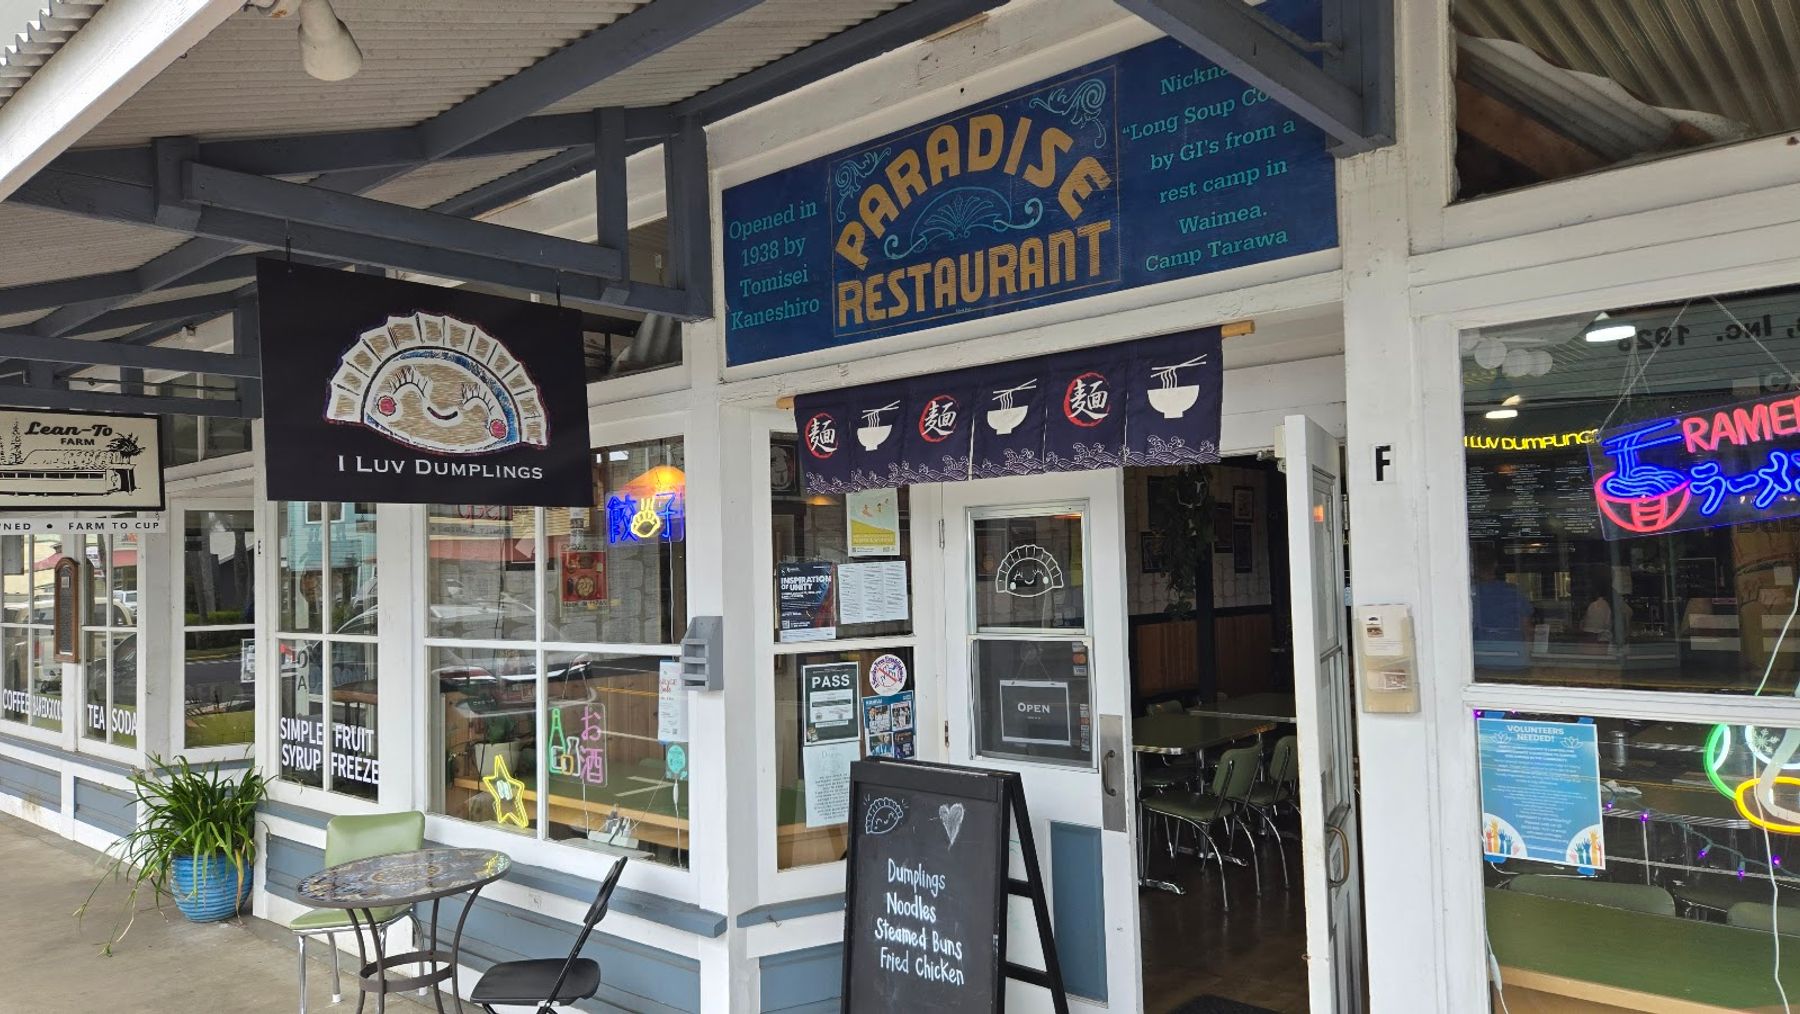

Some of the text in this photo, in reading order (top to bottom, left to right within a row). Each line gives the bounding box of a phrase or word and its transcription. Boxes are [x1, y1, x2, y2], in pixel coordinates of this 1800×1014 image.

[1184, 99, 1235, 124] Soup
[1241, 87, 1274, 106] Co
[1150, 120, 1296, 170] by GI's from a
[835, 114, 1112, 271] PARADISE
[1159, 160, 1288, 203] rest camp in
[729, 200, 818, 240] Opened in
[1178, 205, 1267, 234] Waimea.
[741, 237, 806, 266] 1938 by
[1145, 230, 1288, 271] Camp Tarawa
[739, 264, 808, 297] Tomisei
[838, 219, 1111, 328] RESTAURANT
[731, 298, 819, 330] Kaneshiro
[24, 420, 113, 437] Lean-To
[60, 437, 95, 446] FARM
[1683, 394, 1800, 453] RAME
[1470, 436, 1499, 449] LUV
[338, 455, 345, 471] I
[1375, 445, 1391, 481] F
[1690, 451, 1800, 515] ラーメ
[0, 521, 159, 531] NED FARM TO CUP
[780, 575, 832, 585] INSPIRATION
[812, 674, 850, 688] PASS
[3, 688, 30, 715] COFFEE
[87, 704, 137, 736] TEA SODA
[280, 717, 374, 753] SIMPLE FRUIT
[1506, 725, 1565, 735] VOLUNTEERS
[581, 706, 603, 784] お酒
[282, 743, 379, 785] SYRUP FREEZE
[888, 858, 946, 897] Dumplings
[886, 892, 936, 923] Noodles
[874, 917, 962, 960] Steamed Buns
[880, 947, 965, 985] Fried Chicken
